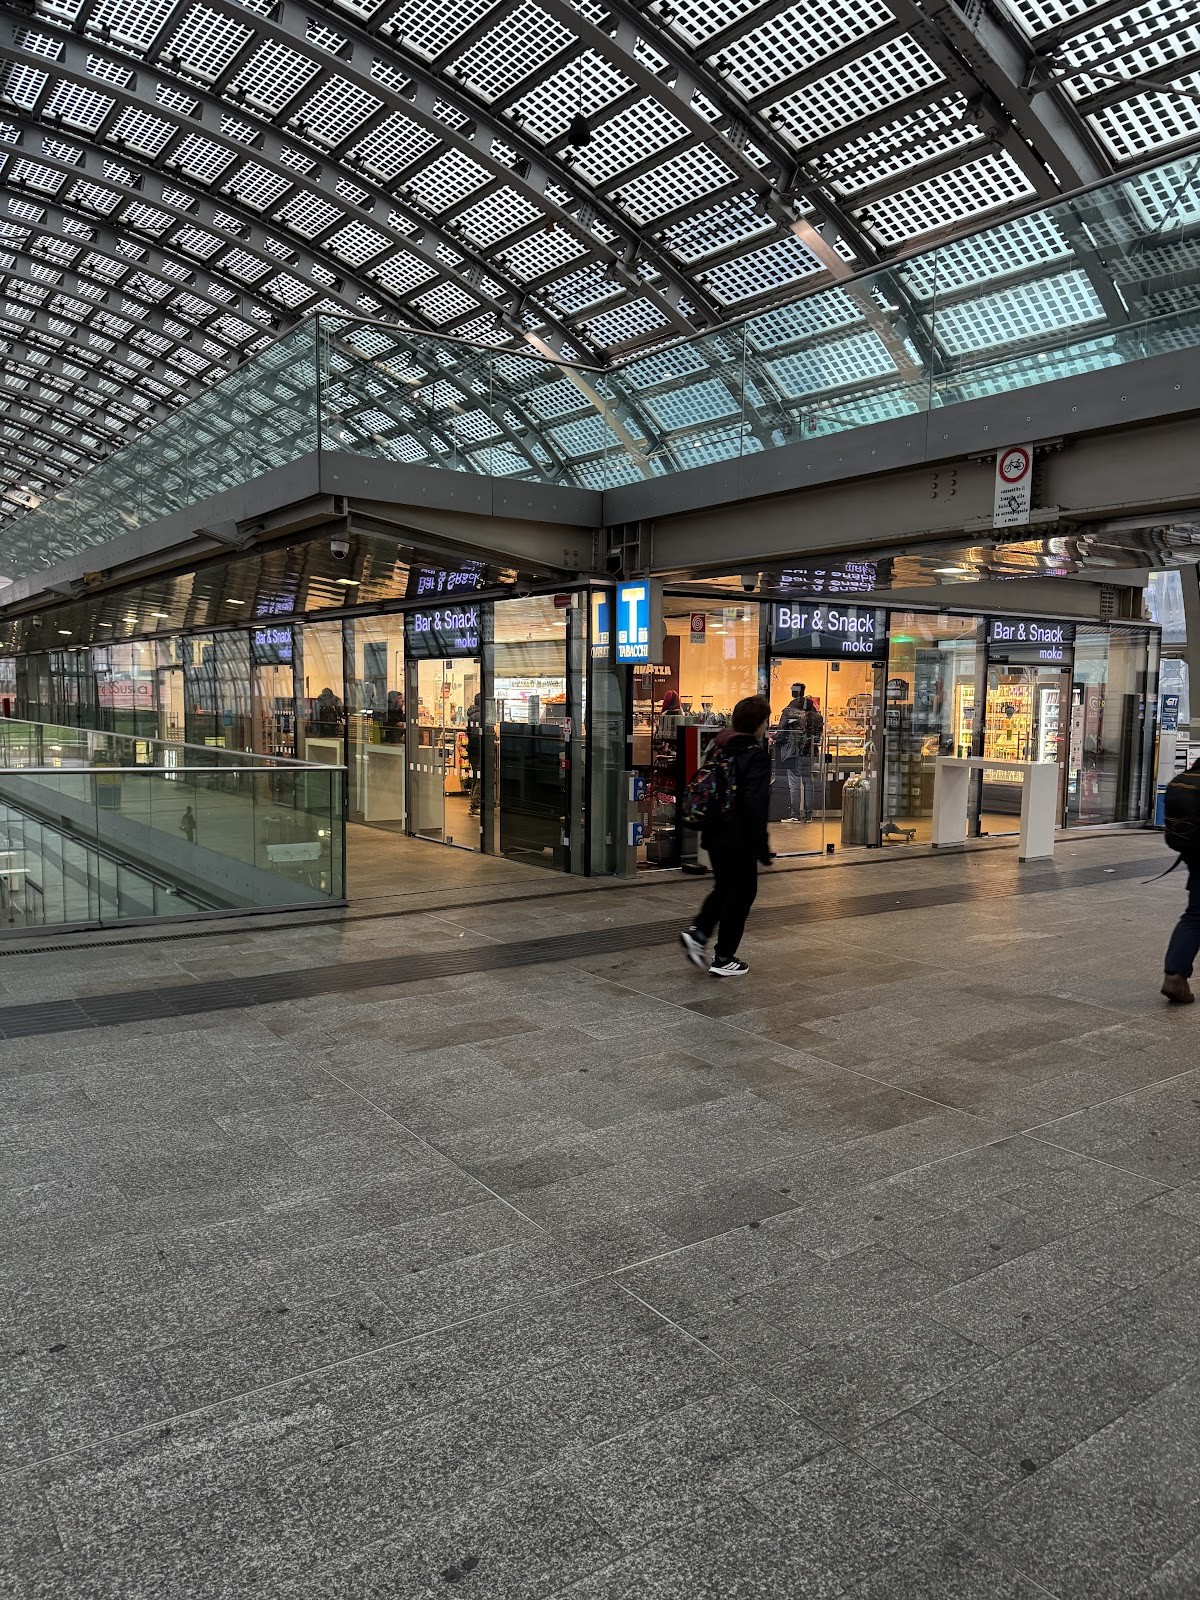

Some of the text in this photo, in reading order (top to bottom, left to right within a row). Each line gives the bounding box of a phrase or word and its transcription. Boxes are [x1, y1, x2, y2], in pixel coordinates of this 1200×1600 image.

[415, 608, 477, 632] Bar & Snack
[779, 607, 874, 632] Bar & Snack
[255, 628, 292, 644] Bar & Snack
[993, 621, 1063, 642] Bar & Snack
[618, 644, 649, 657] TABACCHI
